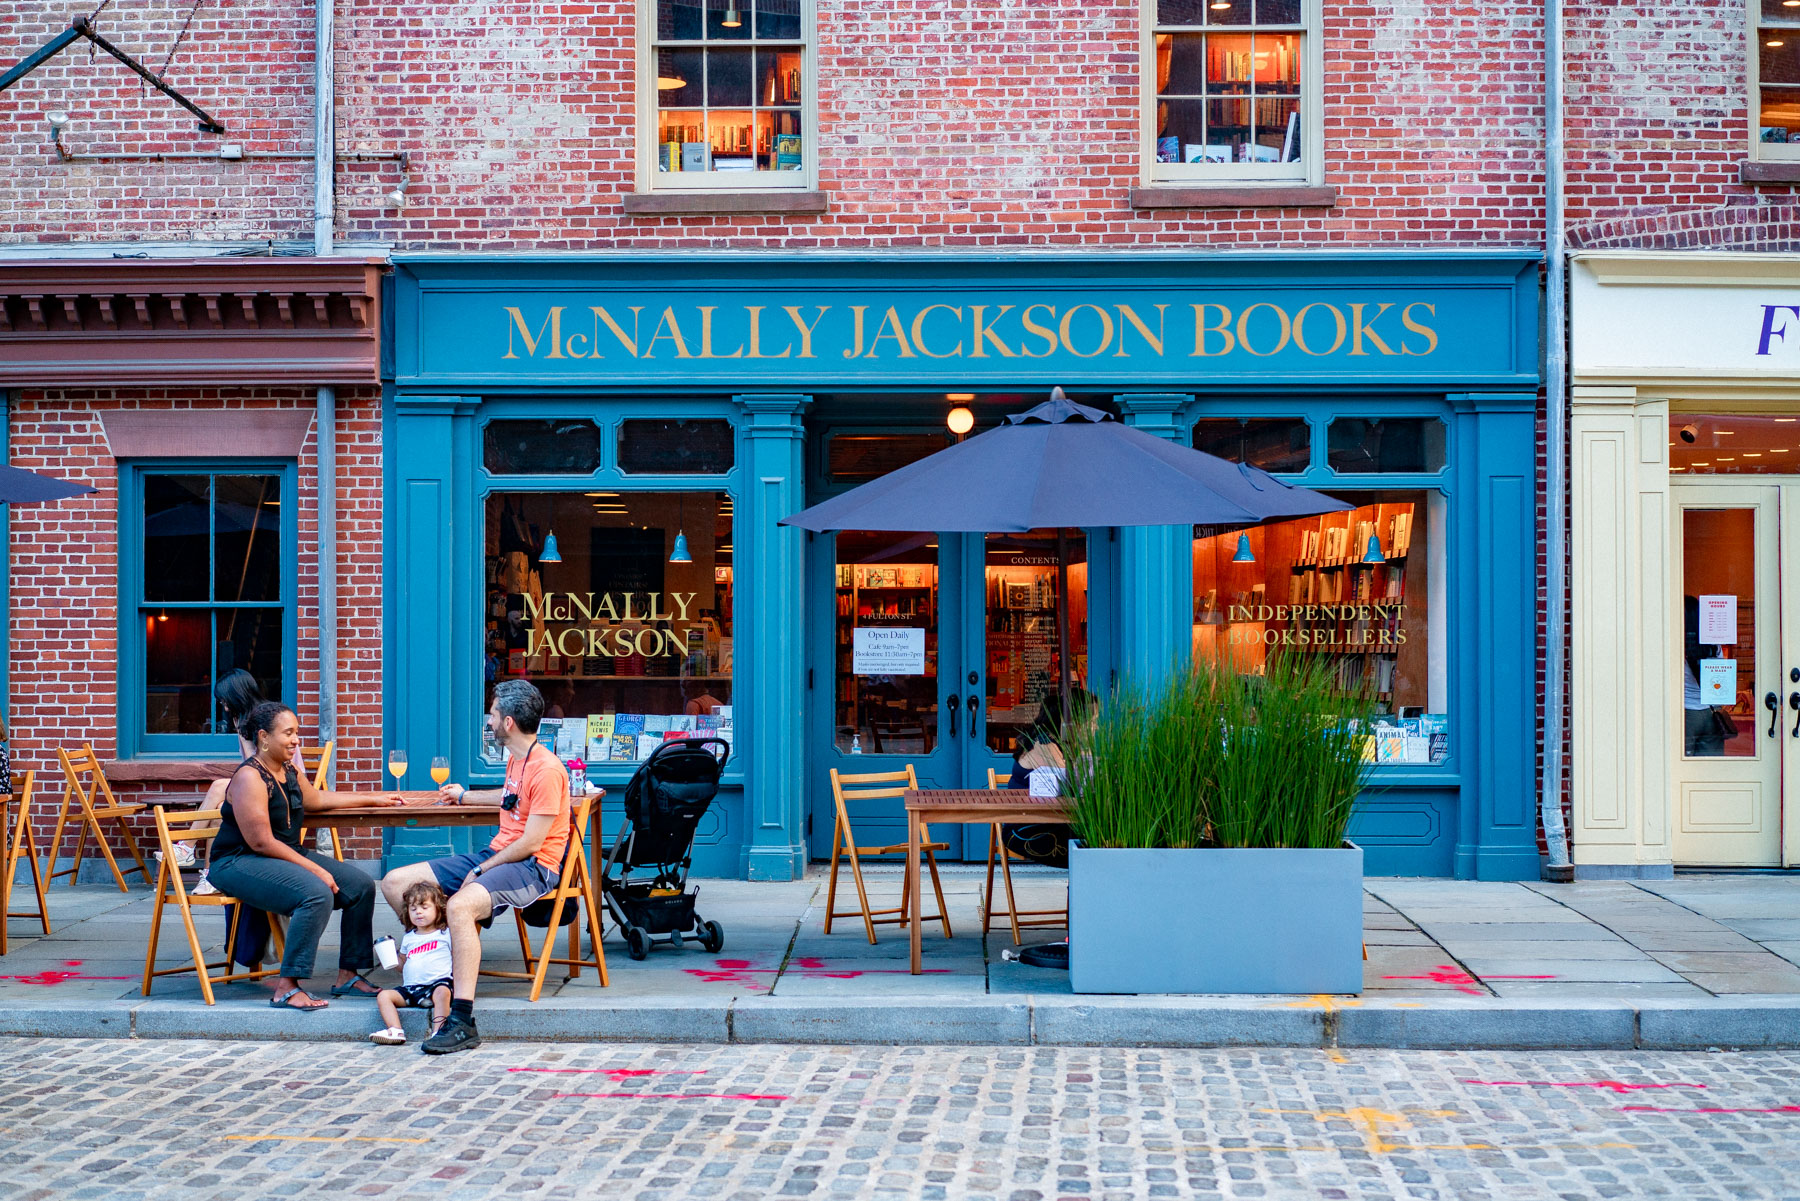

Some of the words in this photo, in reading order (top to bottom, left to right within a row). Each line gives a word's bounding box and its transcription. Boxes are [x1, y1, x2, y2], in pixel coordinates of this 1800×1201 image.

[501, 305, 832, 359] McNALLY
[842, 304, 1171, 358] JACKSON
[1188, 302, 1439, 357] BOOKS
[520, 592, 698, 621] McNALLY
[1228, 604, 1408, 621] INDEPENDENT
[522, 628, 693, 657] JACKSON
[868, 631, 888, 640] Open
[890, 631, 910, 640] Daily
[1228, 628, 1408, 645] BOOKSELLERS
[618, 714, 643, 722] GEORGE
